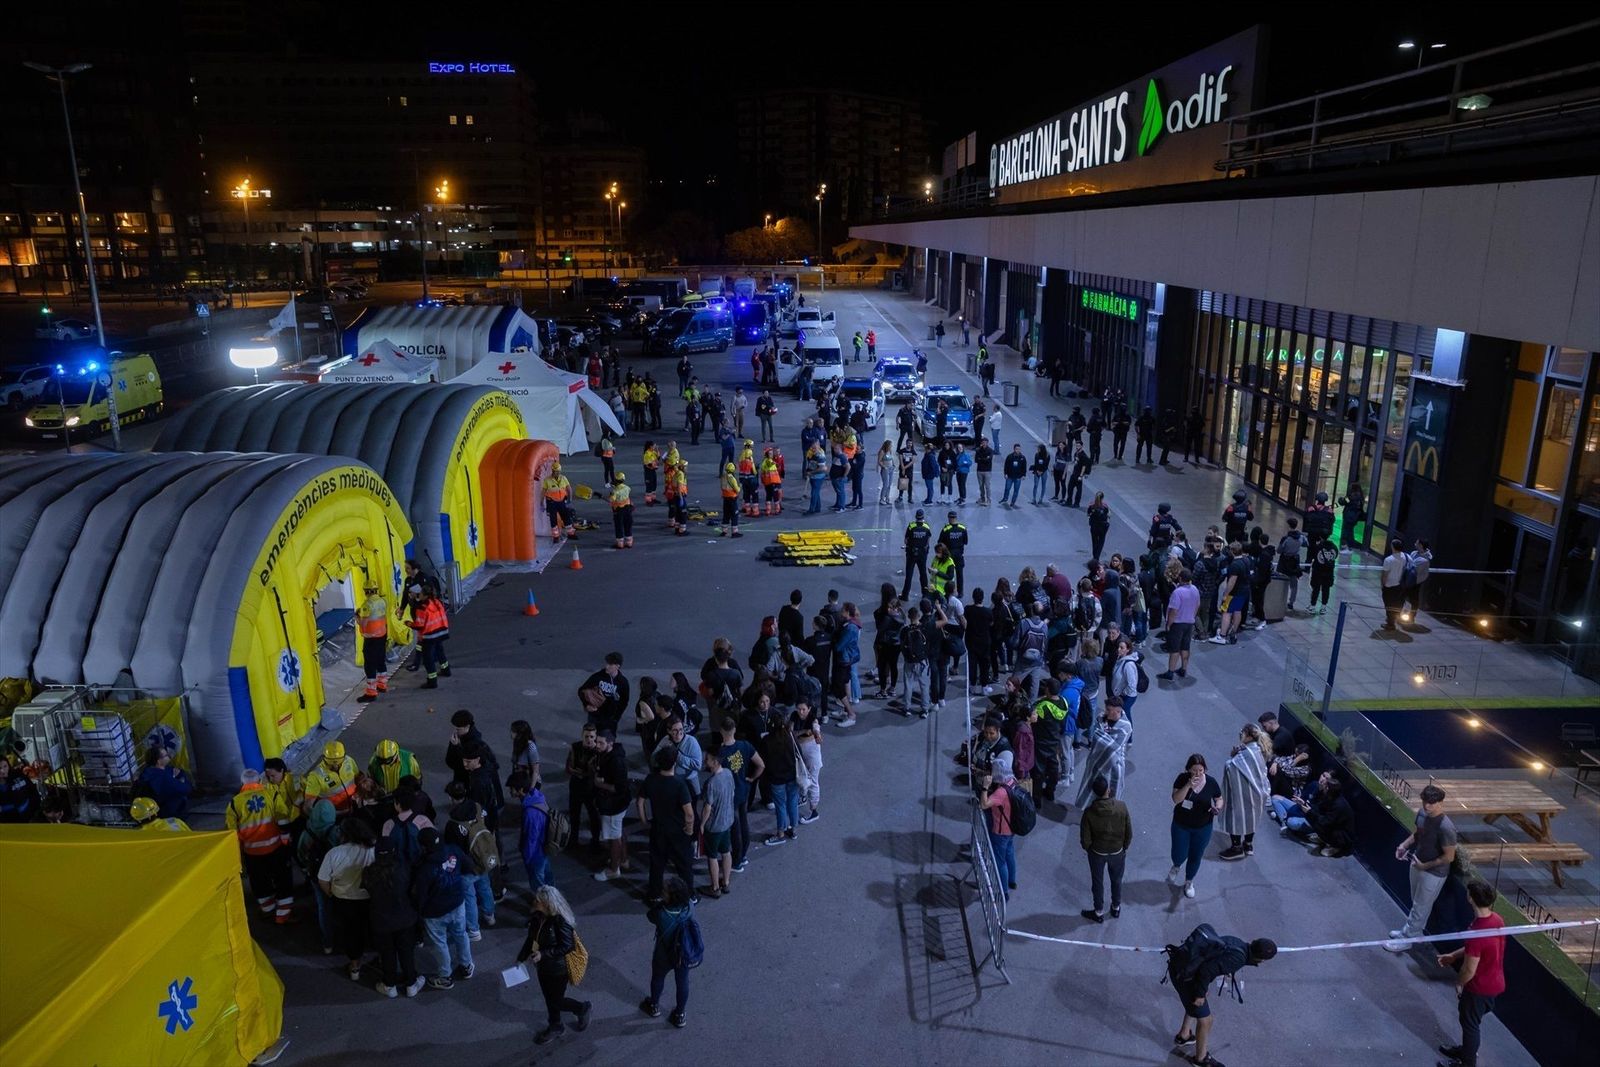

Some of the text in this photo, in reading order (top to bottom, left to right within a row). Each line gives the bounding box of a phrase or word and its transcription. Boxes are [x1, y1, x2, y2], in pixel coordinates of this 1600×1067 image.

[429, 62, 516, 73] EXPO HOTEL
[1166, 65, 1233, 134] adif
[998, 91, 1129, 187] BARCELONA-SANTS
[260, 468, 391, 586] emergències mèdiques
